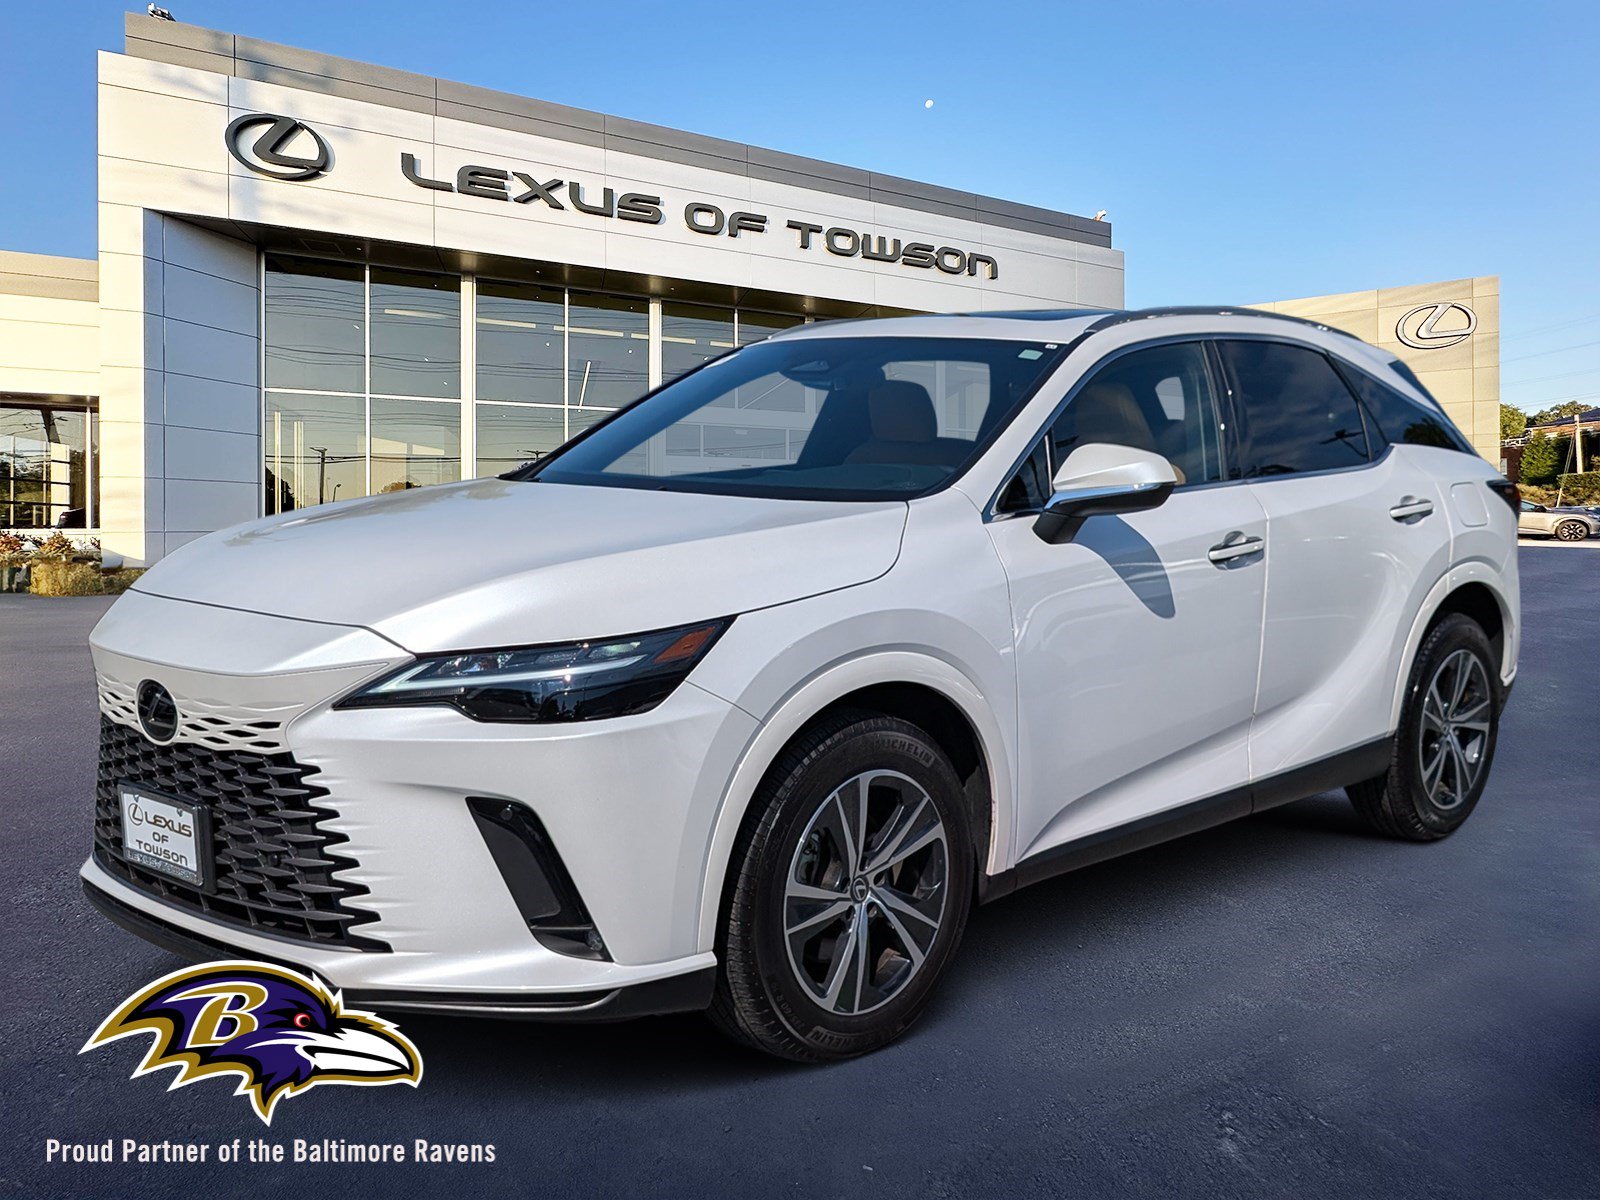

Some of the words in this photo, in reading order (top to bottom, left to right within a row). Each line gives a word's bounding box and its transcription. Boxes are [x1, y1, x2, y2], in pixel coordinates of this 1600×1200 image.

[401, 152, 663, 225] LEXUS
[684, 202, 767, 237] OF
[787, 219, 998, 280] TOWSON
[145, 811, 192, 837] LEXUS
[152, 831, 169, 843] OF
[136, 839, 188, 866] TOWSON
